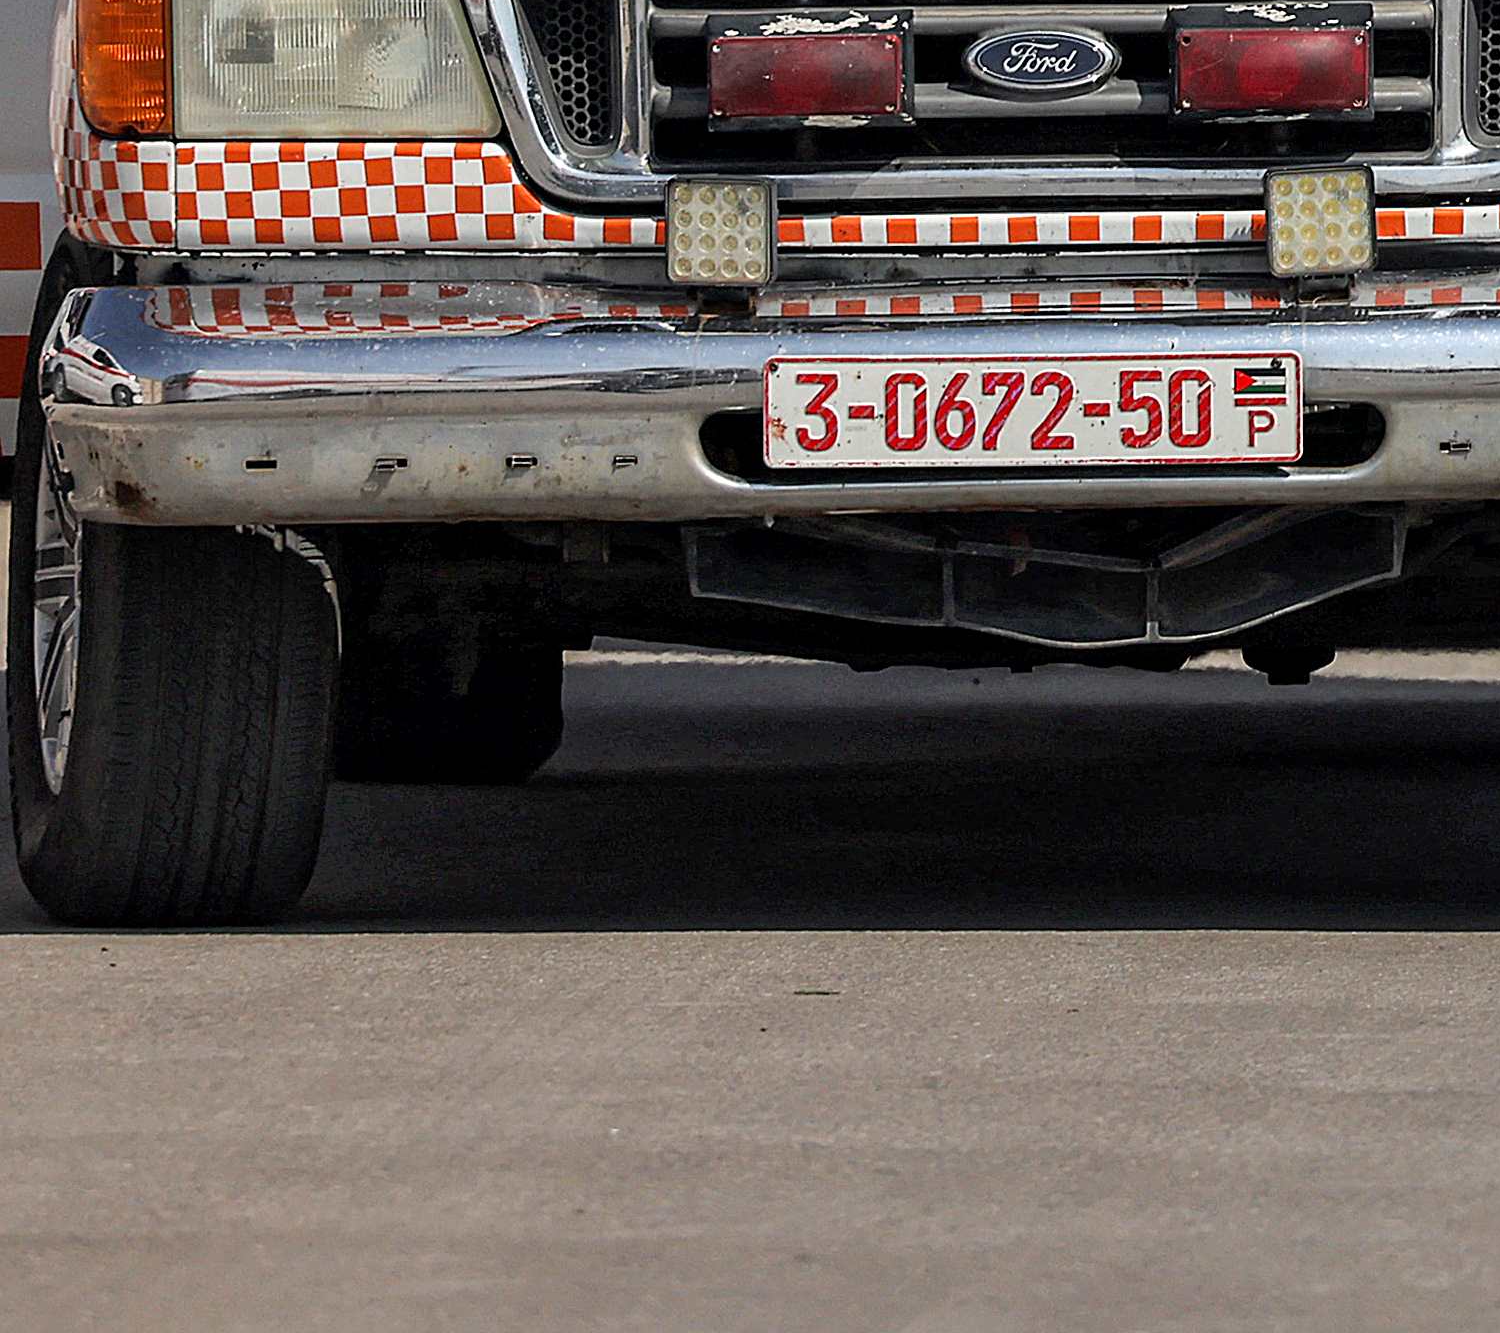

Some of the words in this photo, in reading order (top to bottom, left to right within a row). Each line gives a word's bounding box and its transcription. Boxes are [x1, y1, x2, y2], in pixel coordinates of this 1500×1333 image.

[1003, 41, 1077, 74] Ford
[795, 369, 1214, 451] 3-0672-50
[1248, 410, 1275, 447] P
